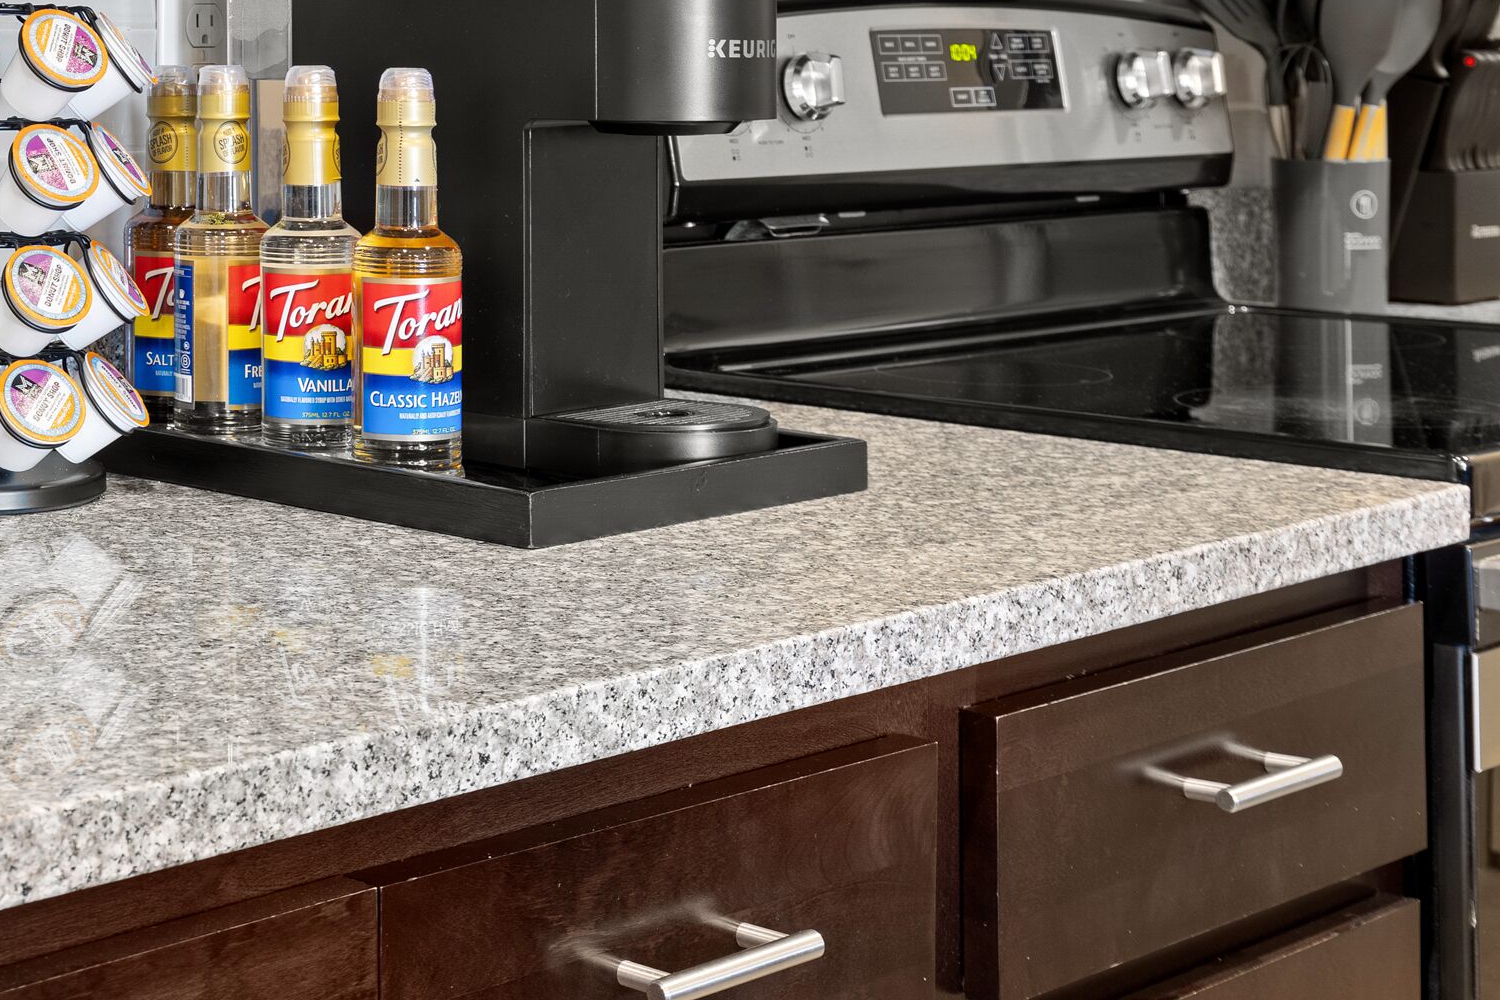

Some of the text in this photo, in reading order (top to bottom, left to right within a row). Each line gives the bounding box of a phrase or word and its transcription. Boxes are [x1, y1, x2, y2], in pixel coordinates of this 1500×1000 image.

[707, 39, 776, 58] KEURIG
[150, 133, 173, 150] SPLASH
[218, 133, 245, 150] SPLASH
[43, 264, 63, 307] DONUT SHOP
[146, 351, 175, 366] SALT
[297, 377, 354, 393] VANILLA
[32, 381, 61, 423] DONUT SHOP
[370, 390, 427, 408] CLASSIC
